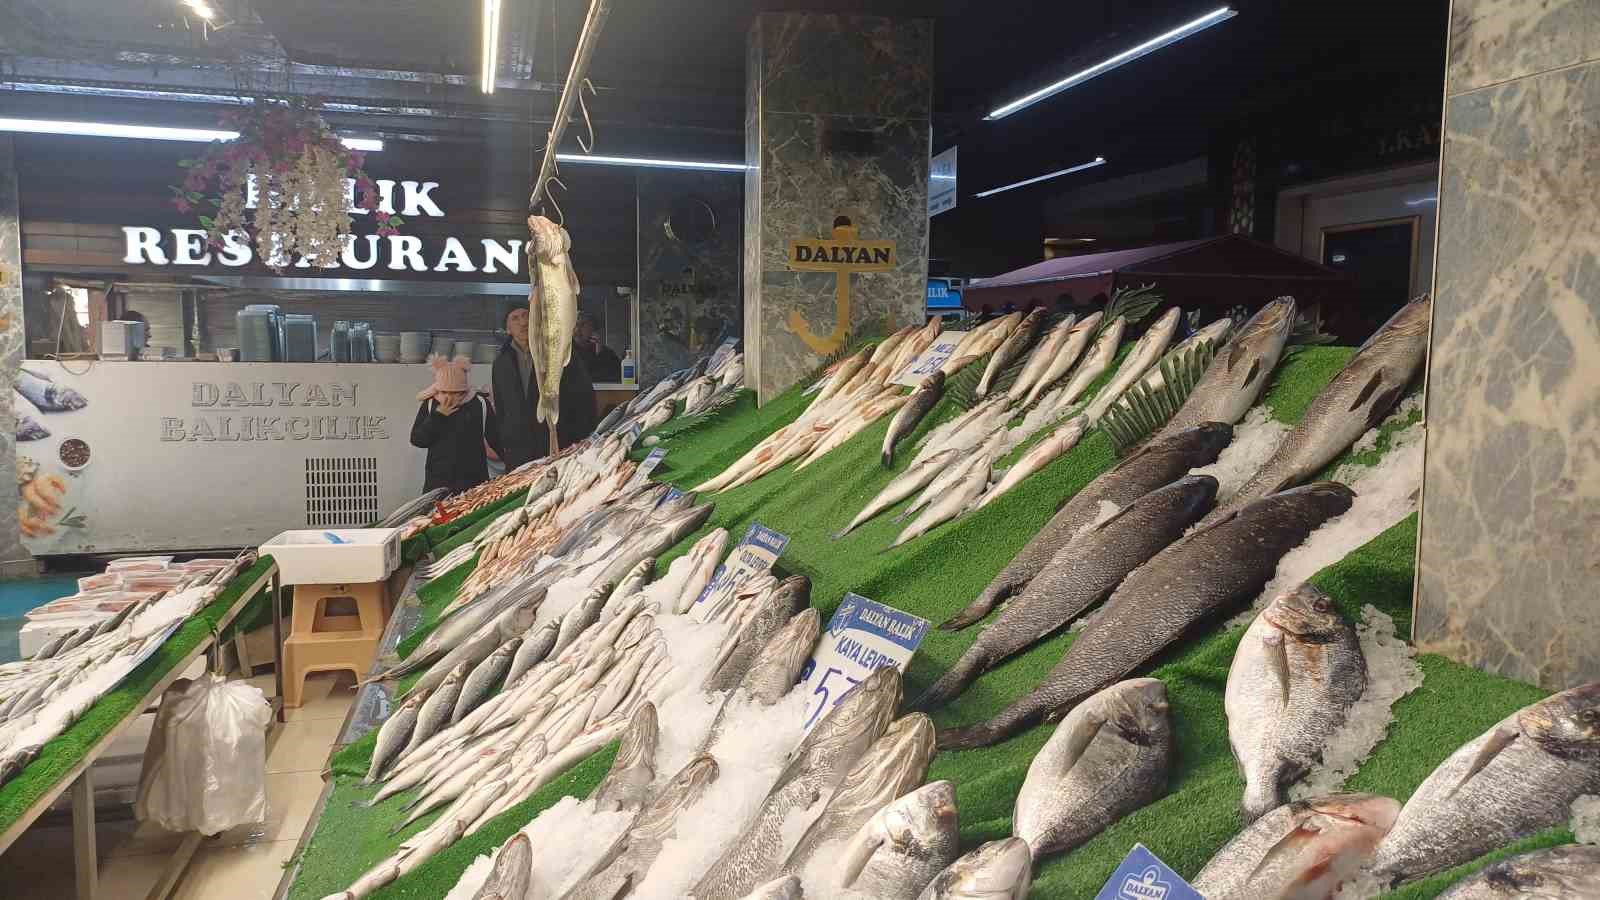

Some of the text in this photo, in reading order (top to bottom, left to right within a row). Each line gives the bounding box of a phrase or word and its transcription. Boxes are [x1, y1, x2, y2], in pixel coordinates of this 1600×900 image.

[245, 174, 445, 217] LIK
[122, 226, 529, 275] RESURAN
[795, 245, 891, 264] DALYAN
[192, 382, 360, 408] DALYAN
[834, 636, 860, 663] KAYA
[1125, 881, 1163, 898] DALYAN
